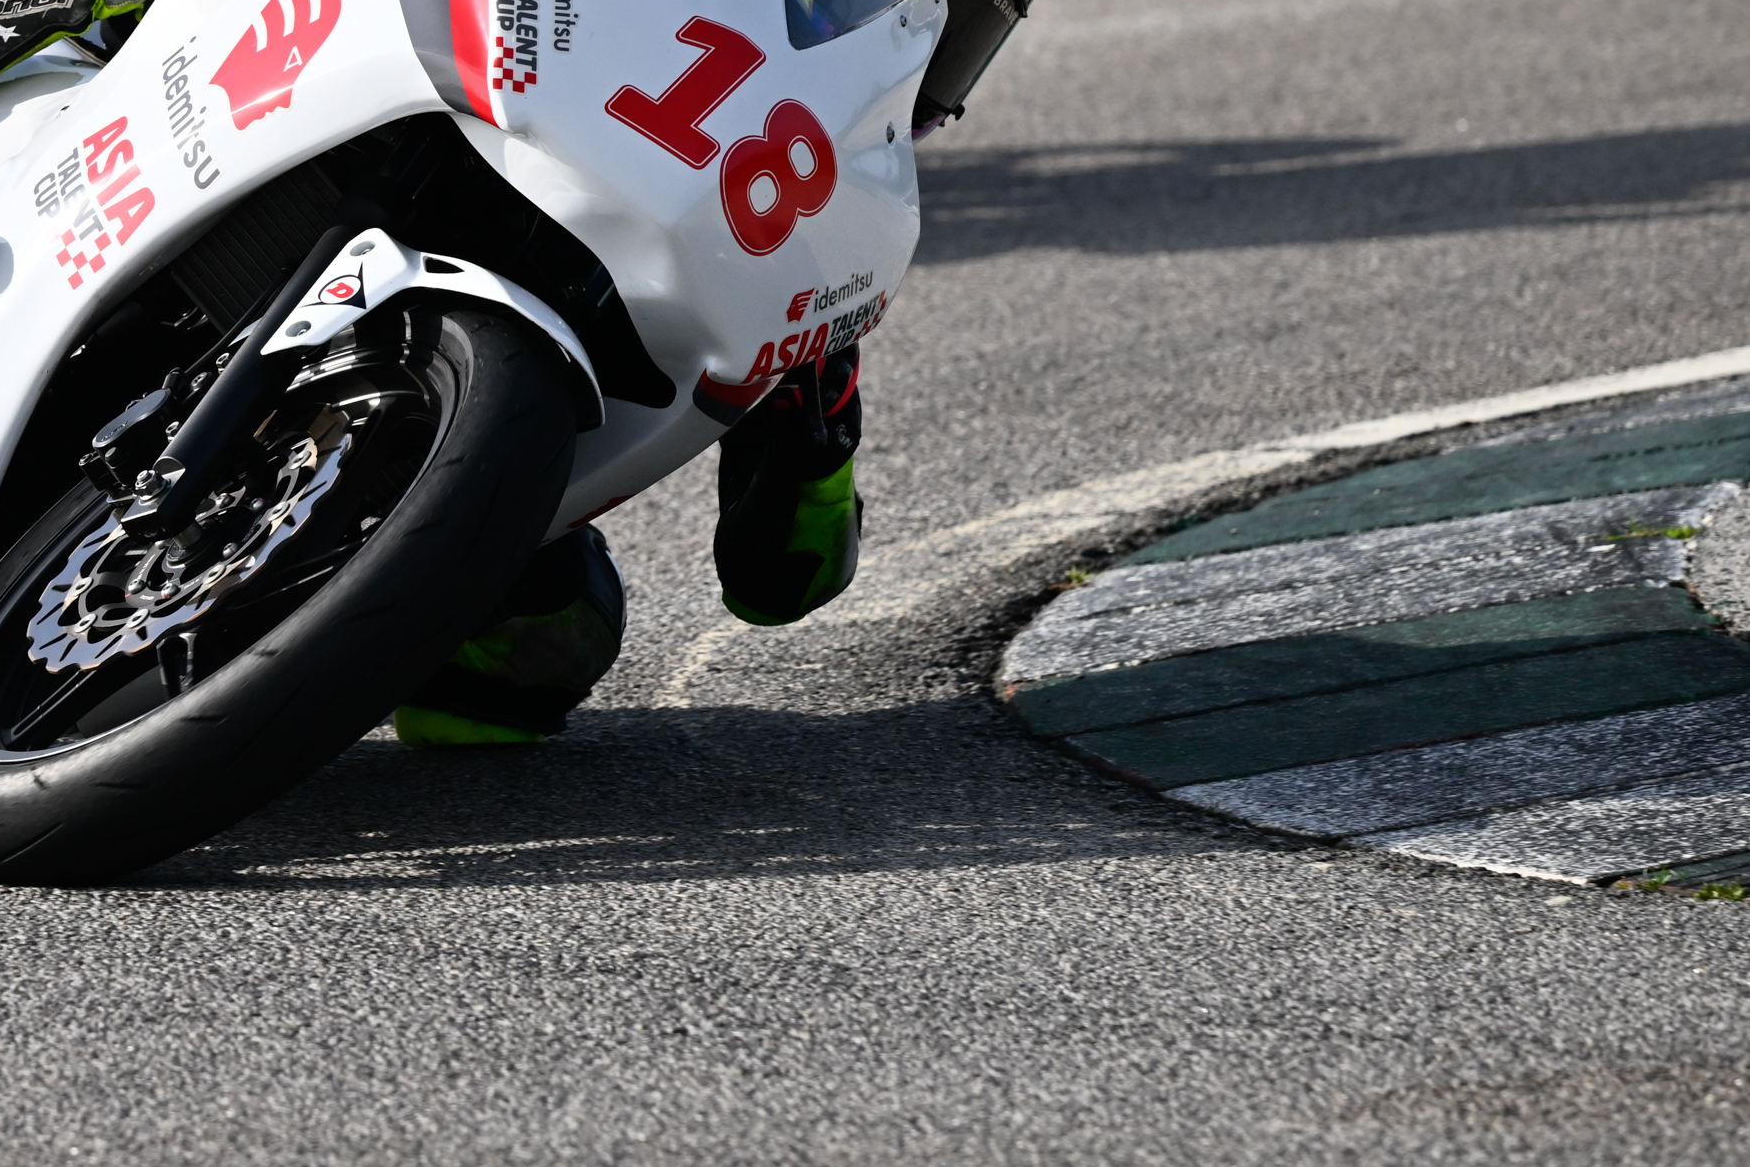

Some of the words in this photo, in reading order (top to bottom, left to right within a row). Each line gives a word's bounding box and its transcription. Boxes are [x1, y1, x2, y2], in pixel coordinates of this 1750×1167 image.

[162, 35, 221, 190] idemitsu
[604, 16, 838, 256] 18
[33, 172, 61, 218] CUP
[57, 147, 104, 241] TALENT
[83, 115, 156, 247] ASIA
[814, 271, 873, 313] idemitsu
[829, 294, 880, 338] TALENT
[741, 322, 829, 384] ASIA
[823, 328, 856, 356] CUP
